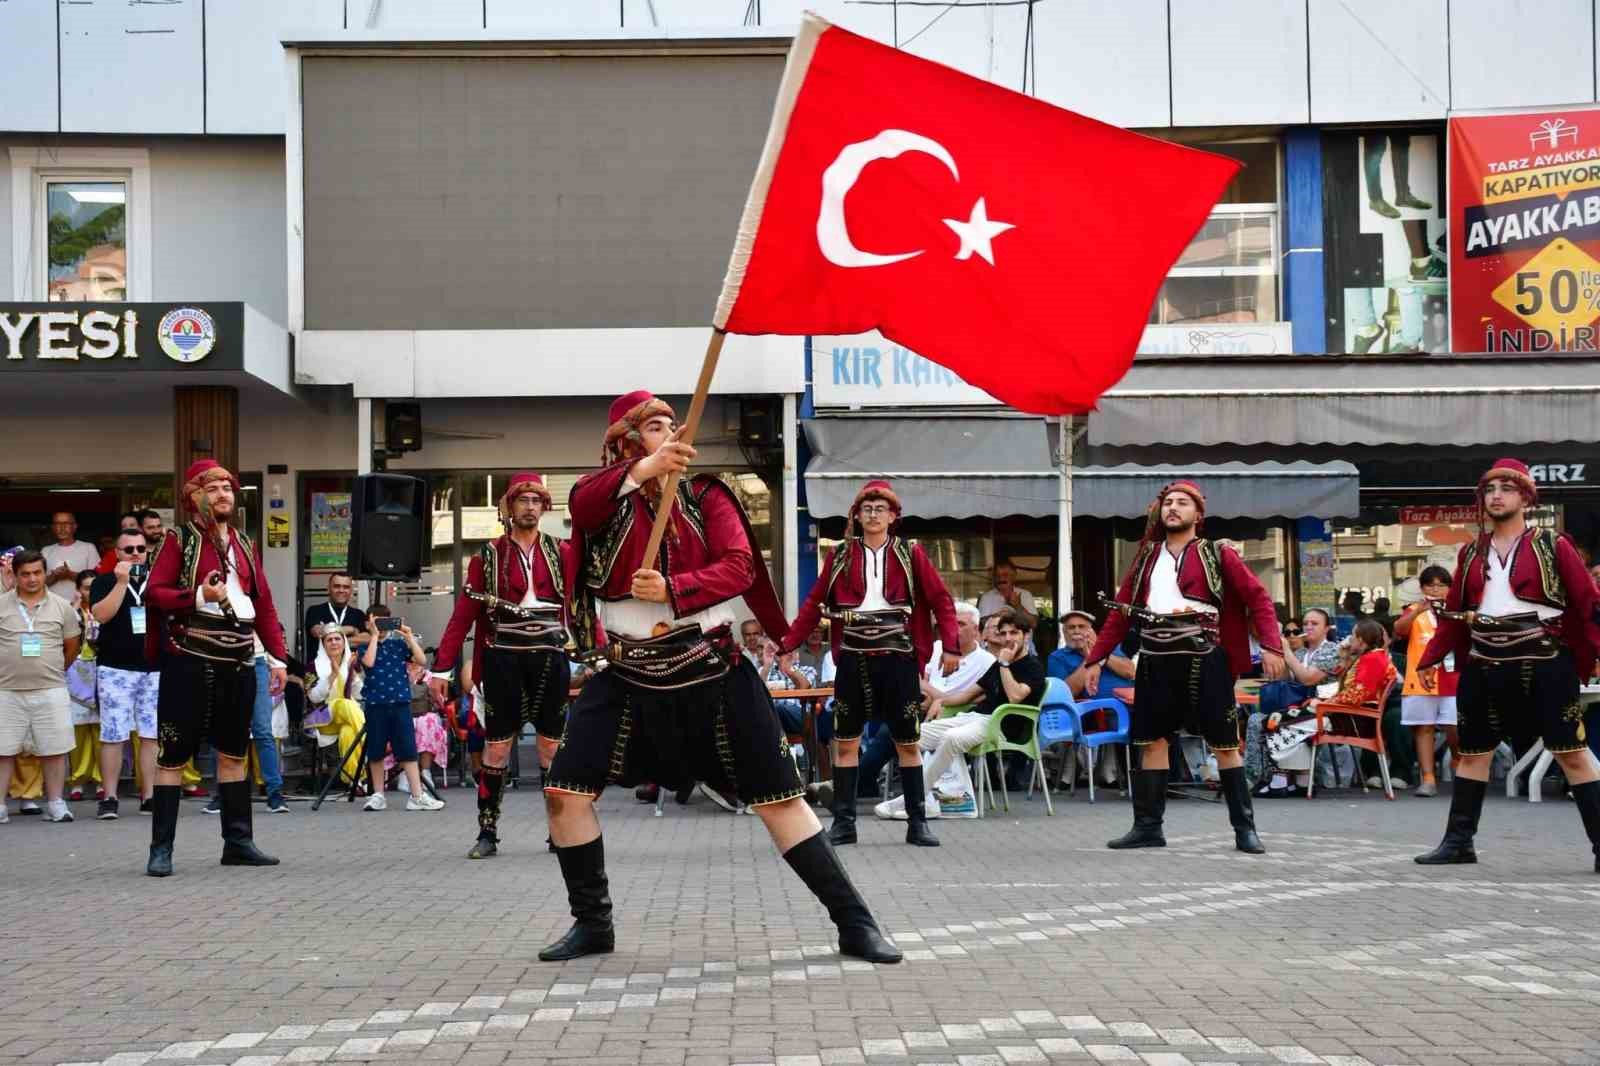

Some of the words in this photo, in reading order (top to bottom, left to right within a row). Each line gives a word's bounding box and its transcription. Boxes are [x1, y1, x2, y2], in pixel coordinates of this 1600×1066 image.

[1488, 157, 1529, 173] TARZ
[1534, 147, 1600, 166] AYAKKA
[1515, 269, 1579, 316] 50
[832, 347, 882, 388] KIR
[1526, 463, 1585, 482] ARZ
